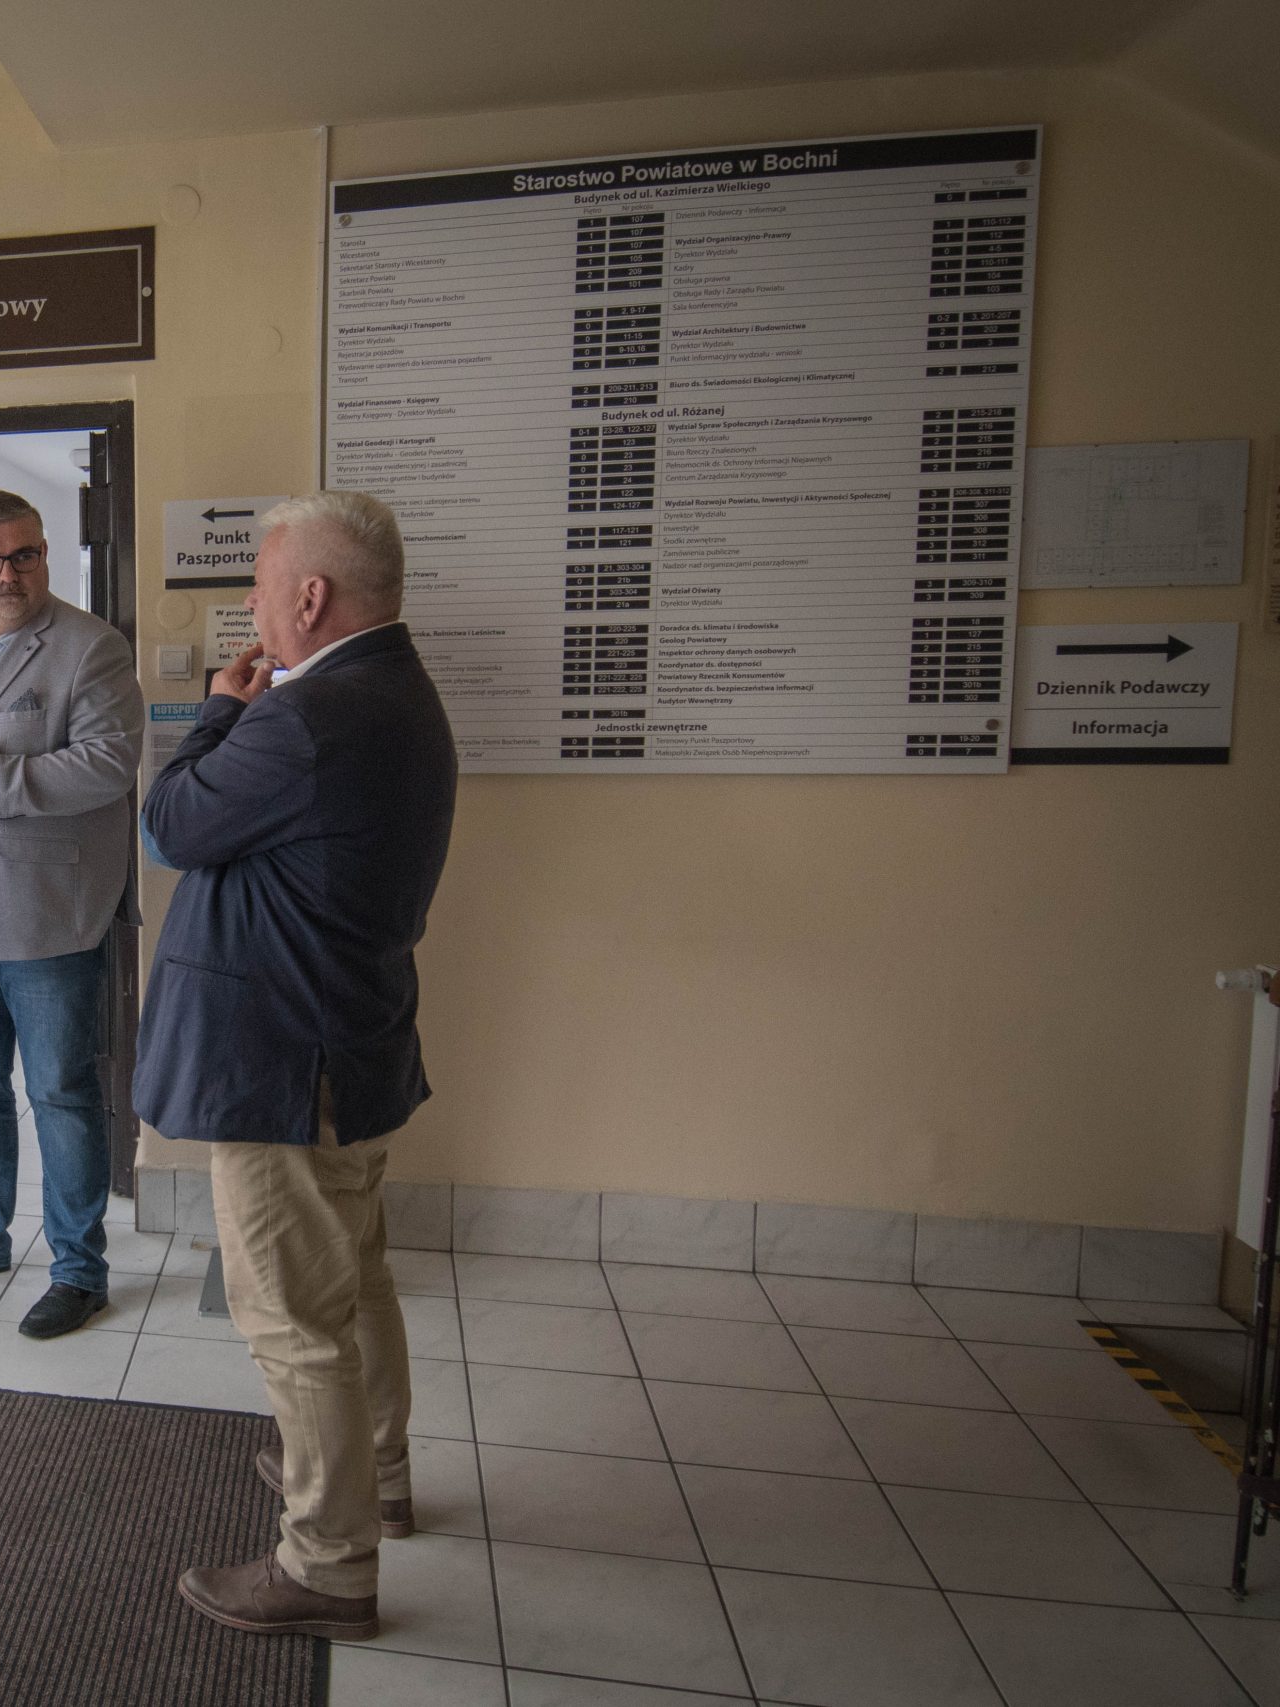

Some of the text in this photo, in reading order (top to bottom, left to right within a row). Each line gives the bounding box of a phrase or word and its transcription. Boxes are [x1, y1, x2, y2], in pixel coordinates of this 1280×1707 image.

[512, 149, 838, 191] Starostwo Powiatowe w Bochni
[574, 180, 771, 205] Budynek od ul. Kazimierza Wielkiego
[674, 231, 791, 247] Wydział Organizacyjno-Prawny
[339, 250, 380, 259] Wicestarosta
[374, 261, 400, 270] Starosty
[404, 257, 445, 268] Wicestarosty
[673, 264, 694, 273] Kadry
[339, 276, 368, 284] Sekretarz
[338, 320, 451, 335] Wydział Komunikacji Transportu
[671, 322, 806, 338] Wydział Architektury Budownictwa
[338, 376, 368, 385] Transport
[703, 376, 752, 386] Świadomości
[753, 375, 801, 385] Ekologicznej
[806, 372, 855, 382] Klimatycznej
[337, 400, 364, 409] Wydział
[406, 396, 439, 405] Księgowy
[601, 406, 725, 422] Budynek od ul. Różanej
[667, 414, 872, 432] Wydział Spraw Społecznych Zarządzania Kryzysowego
[336, 436, 435, 449] Wydział Geodezji Kartografii
[664, 492, 890, 508] Wydział Rozwoju Powiatu, Inwestycji Aktywności Społecznej
[204, 530, 251, 544] Punkt
[176, 552, 258, 567] Paszporto
[661, 587, 721, 596] Wydział Oświaty
[660, 600, 690, 608] Dyrektor
[686, 636, 727, 644] Powiatowy
[658, 648, 796, 657] Inspektor ochrony danych osobowych
[658, 661, 704, 670] Koordynator
[717, 660, 761, 669] dostępności
[657, 673, 697, 681] Powiatowy
[657, 685, 703, 693] Koordynator
[716, 685, 774, 693] bezpieczeństwa
[775, 684, 814, 692] informacji
[1036, 680, 1210, 696] Dziennik Podawczy
[154, 705, 196, 714] HOTSPOT
[646, 723, 707, 732] zewnętrzne
[1072, 720, 1169, 737] Informacja
